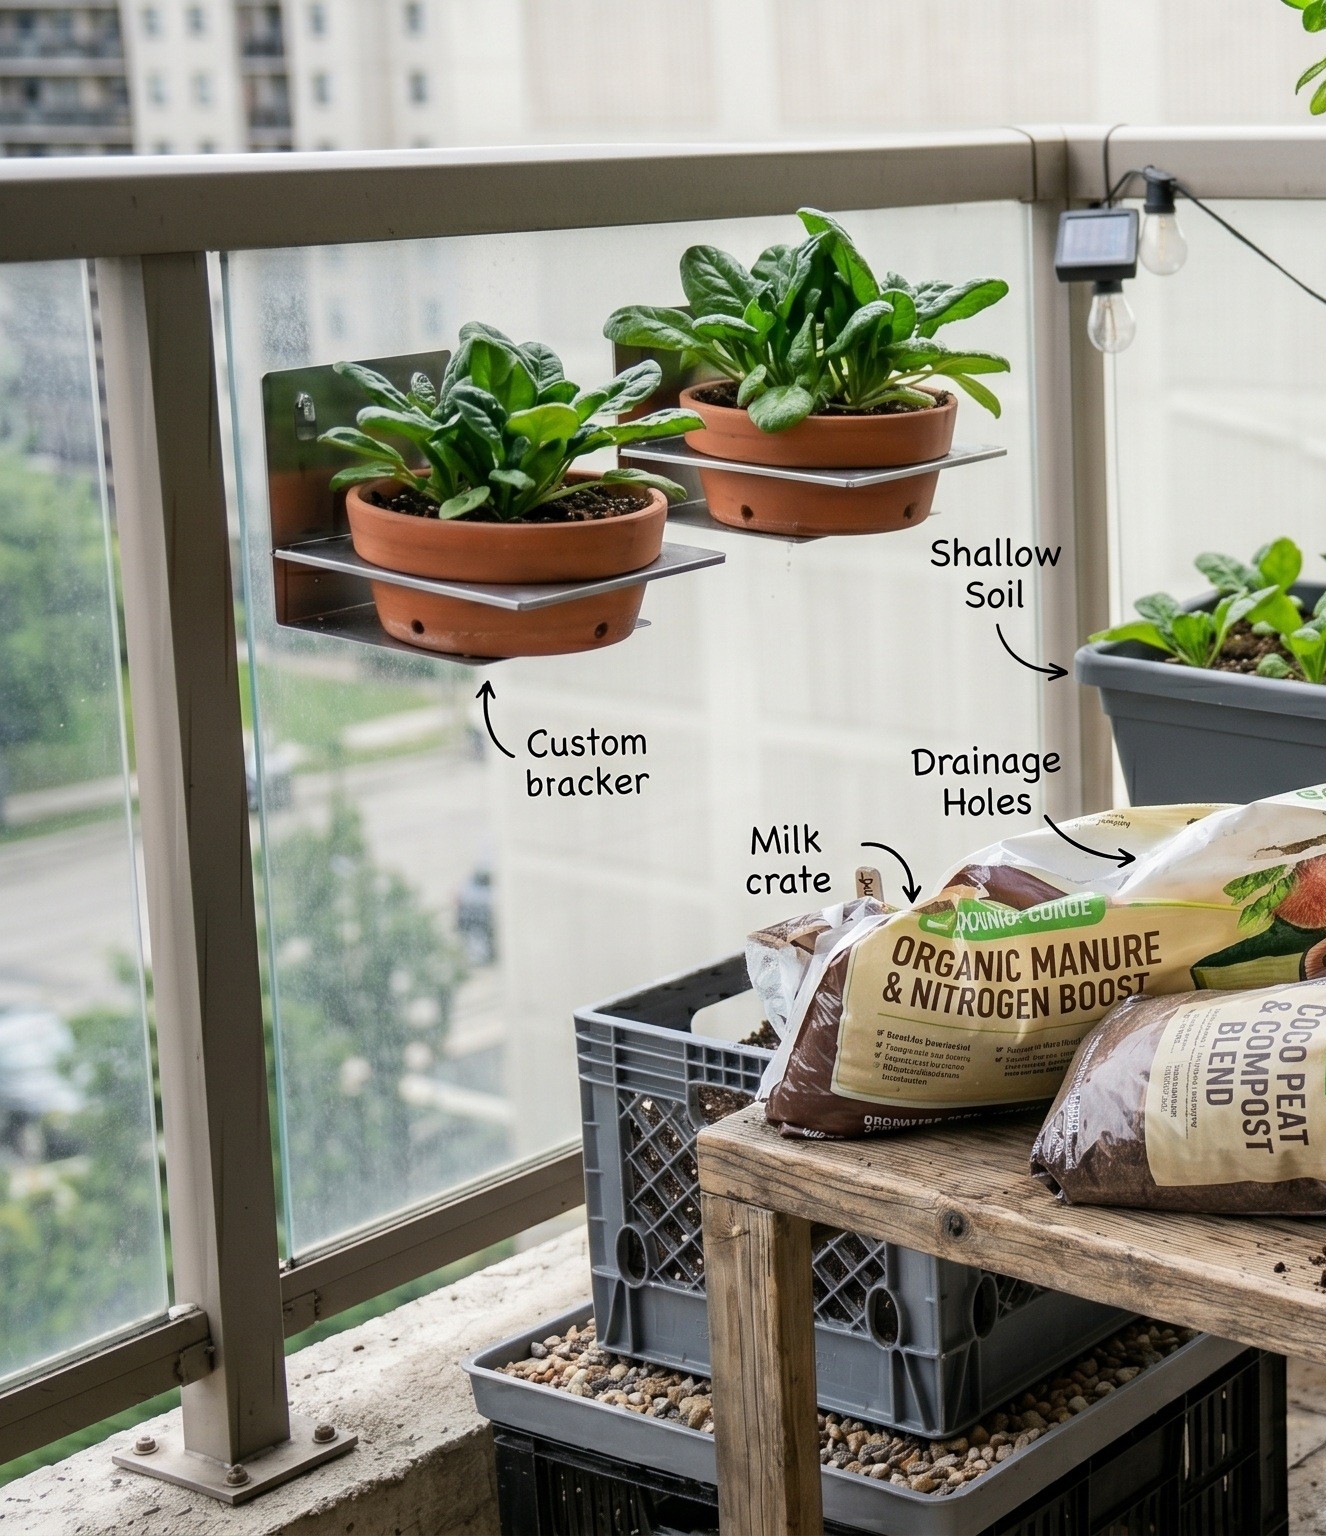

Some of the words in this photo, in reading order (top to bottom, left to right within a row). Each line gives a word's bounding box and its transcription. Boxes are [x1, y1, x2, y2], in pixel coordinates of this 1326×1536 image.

[891, 935, 1022, 983] ORGANIC
[1031, 930, 1162, 981] MANURE
[882, 971, 902, 1004] &
[910, 977, 1050, 1020] NITROGEN
[1059, 971, 1150, 1014] BOOST
[1258, 1000, 1292, 1013] &
[1206, 1021, 1247, 1107] BLEND
[1240, 1020, 1282, 1154] COMPOST
[1276, 1073, 1309, 1146] PEAT
